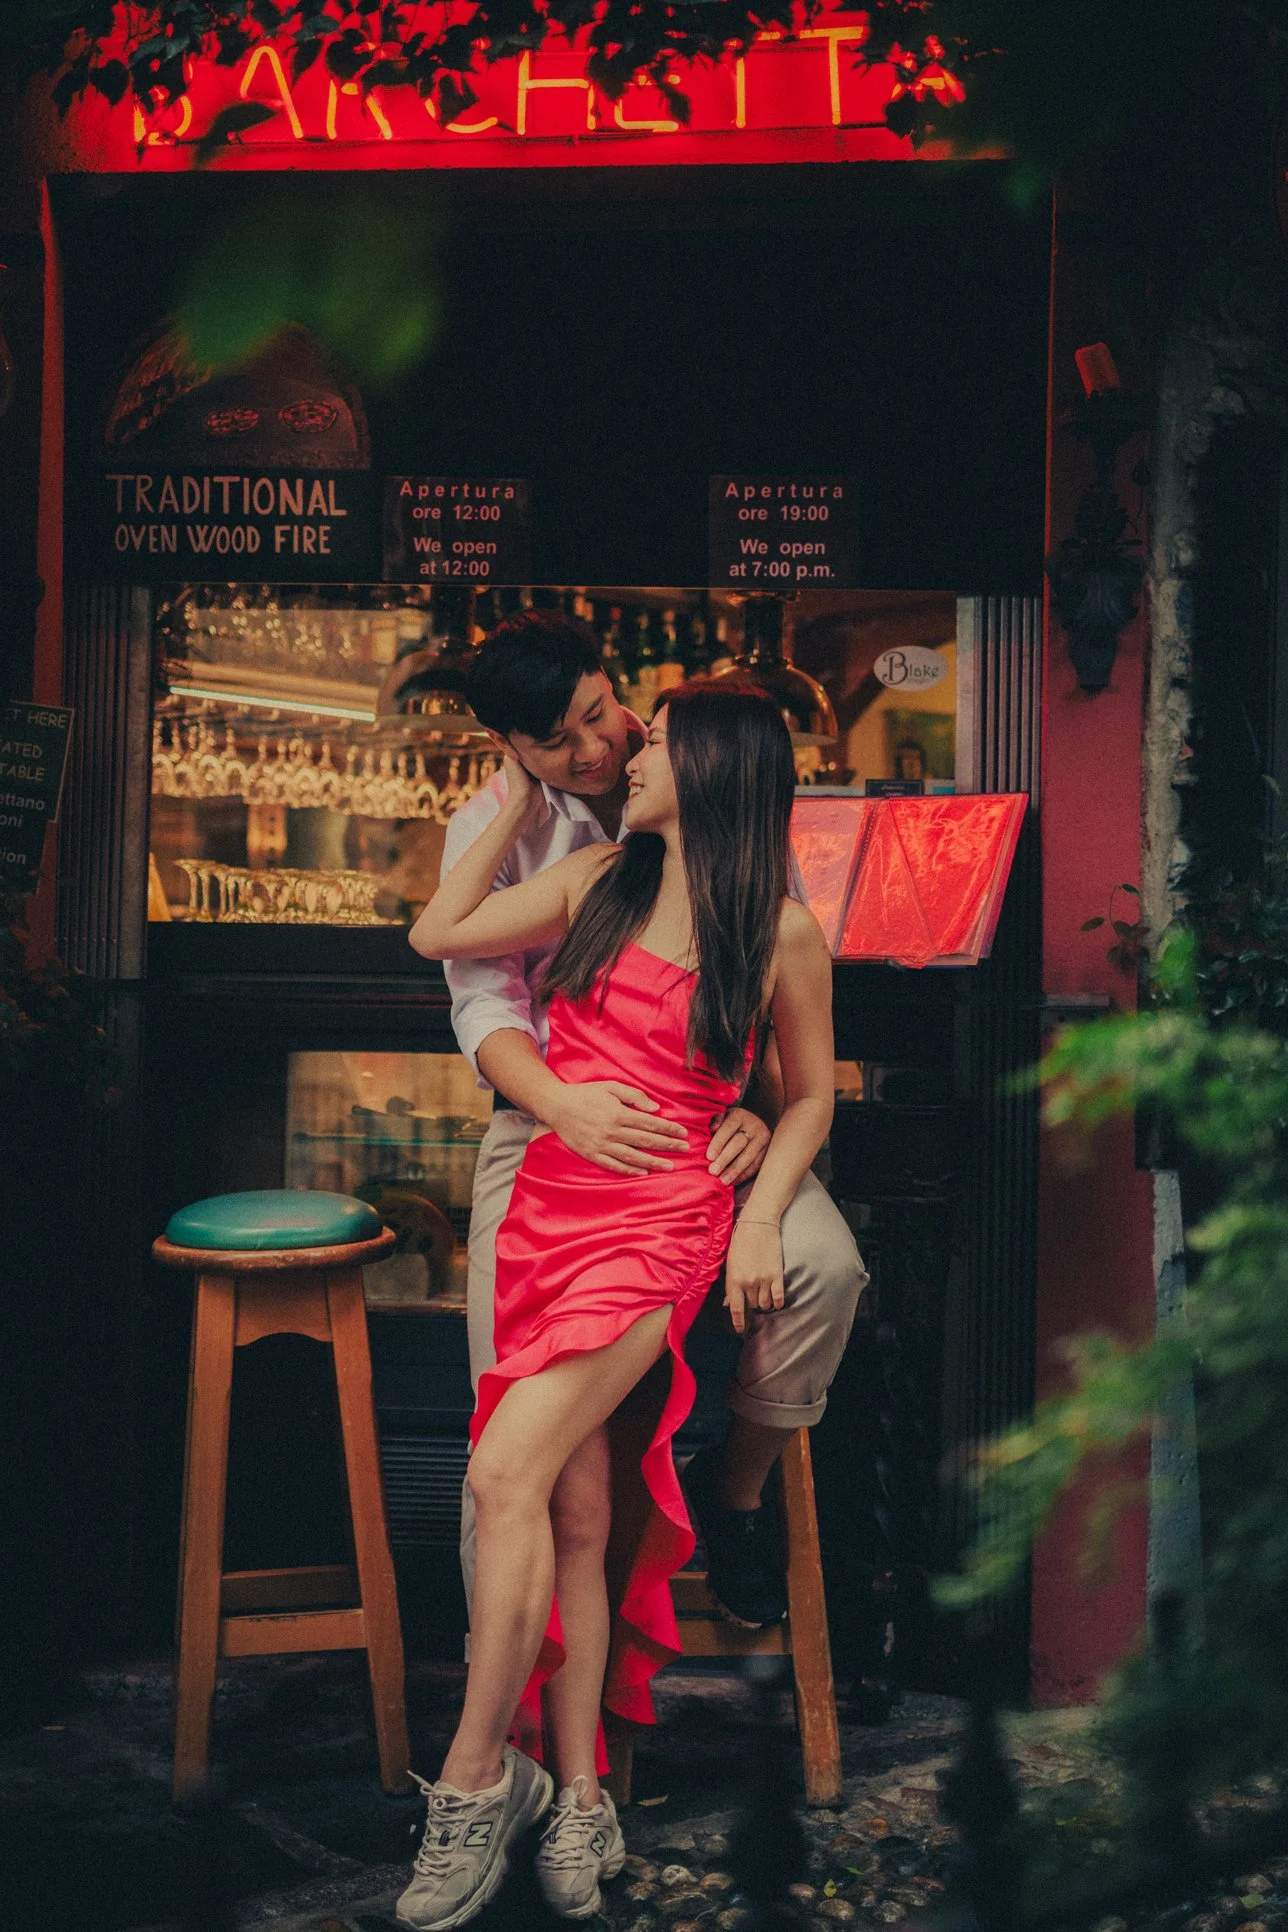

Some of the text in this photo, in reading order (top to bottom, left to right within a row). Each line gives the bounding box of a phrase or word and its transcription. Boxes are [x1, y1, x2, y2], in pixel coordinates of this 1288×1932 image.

[105, 473, 347, 517] TRADITIONAL
[399, 480, 516, 501] Apertura
[724, 481, 844, 501] Apertura
[411, 503, 501, 521] ore 12:00
[737, 504, 830, 522] ore 19:00
[114, 524, 331, 554] OVEN WOOD FIRE
[413, 536, 498, 557] We open
[739, 537, 826, 559] We open
[418, 558, 490, 577] at 12:00
[728, 560, 836, 581] at 7:00 p.m.
[27, 710, 68, 729] HERE
[0, 740, 43, 758] ATED
[0, 762, 45, 781] TABLE
